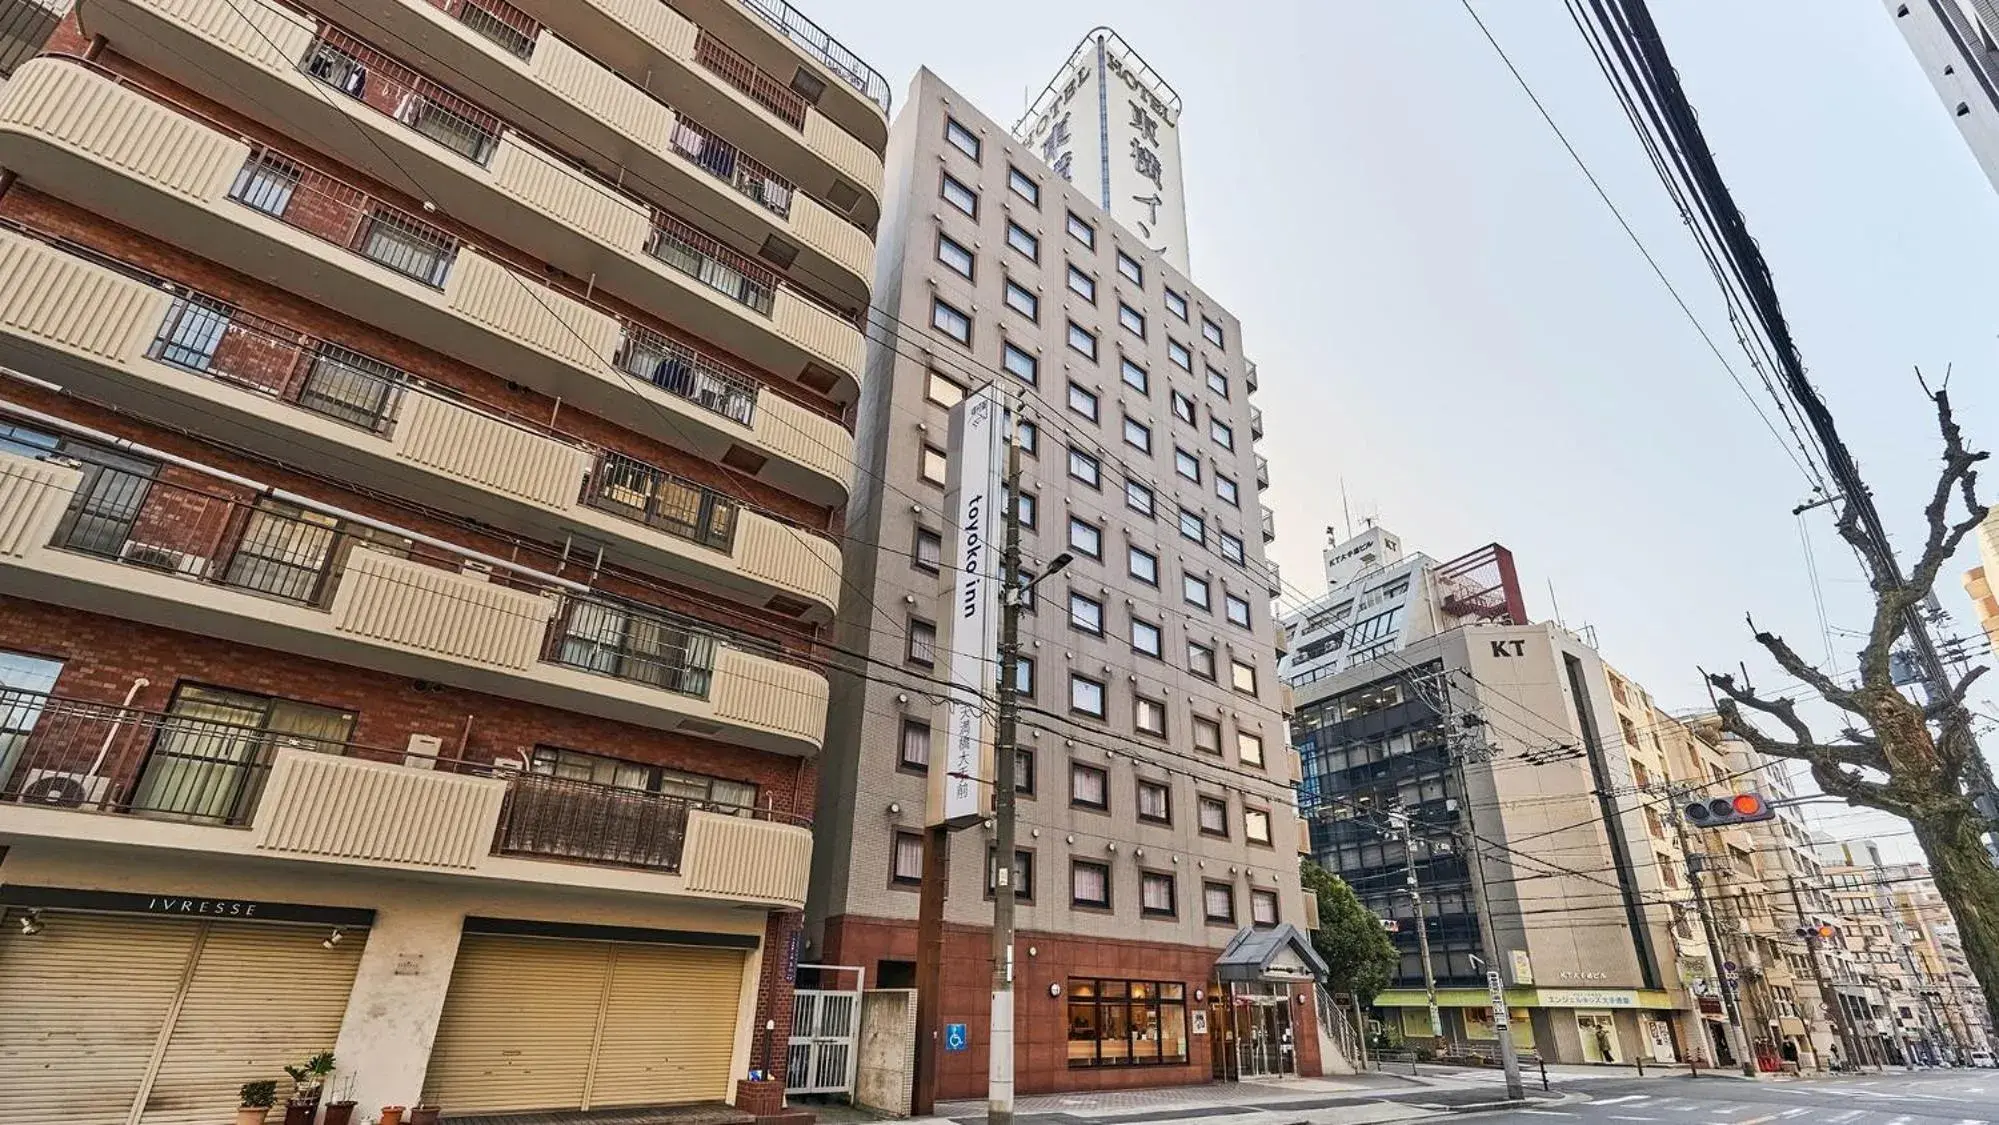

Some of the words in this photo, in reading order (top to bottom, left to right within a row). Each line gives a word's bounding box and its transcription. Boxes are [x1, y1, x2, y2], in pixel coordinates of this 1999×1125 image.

[1023, 66, 1092, 149] HOTEL
[1106, 50, 1175, 128] HOTEL
[1128, 99, 1168, 254] 東横イン
[964, 493, 984, 576] toyoko
[1384, 537, 1398, 552] KT
[963, 578, 981, 619] inn
[1490, 638, 1527, 659] KT
[147, 897, 258, 917] IVRESSE
